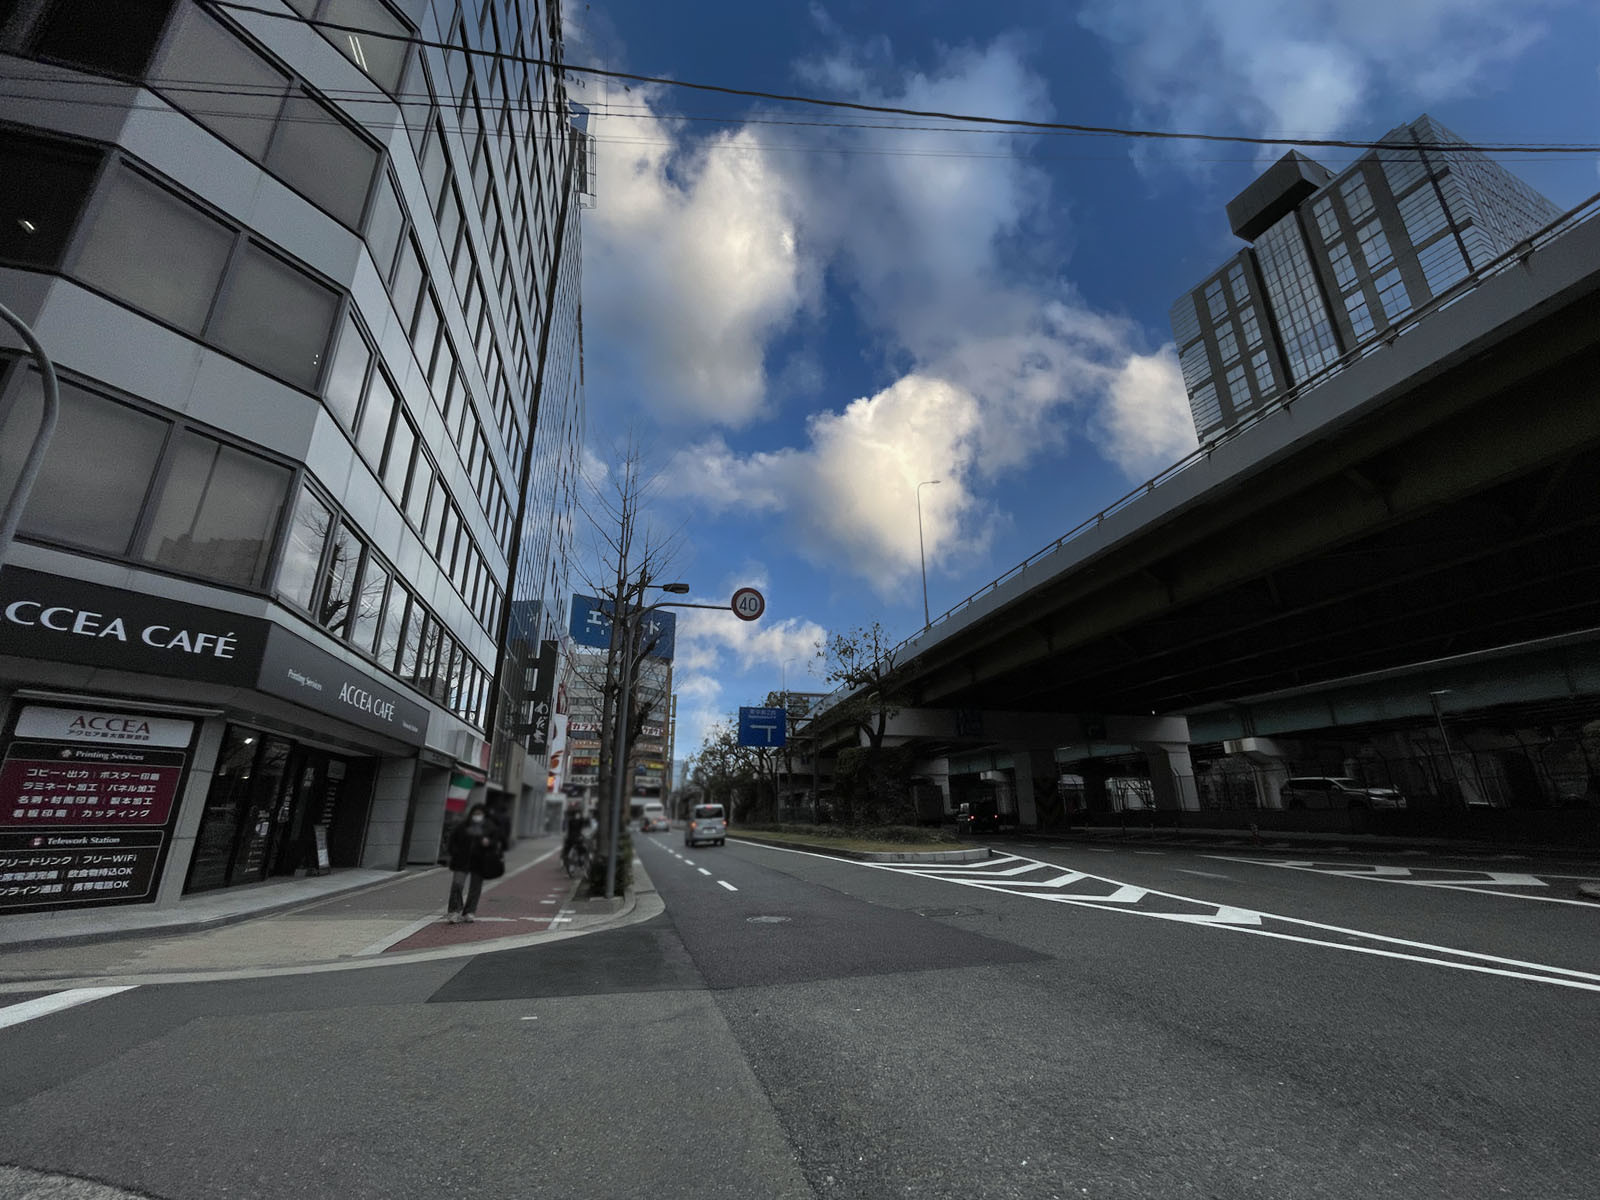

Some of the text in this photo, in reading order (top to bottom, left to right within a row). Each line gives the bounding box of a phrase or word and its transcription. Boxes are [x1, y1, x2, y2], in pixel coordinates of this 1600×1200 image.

[739, 597, 758, 612] 40
[0, 600, 238, 659] CCEA CAFÉ
[339, 682, 395, 721] ACCEA CAFÉ
[70, 716, 150, 734] ACCEA
[76, 751, 144, 761] Printing Services
[47, 837, 88, 845] Telework
